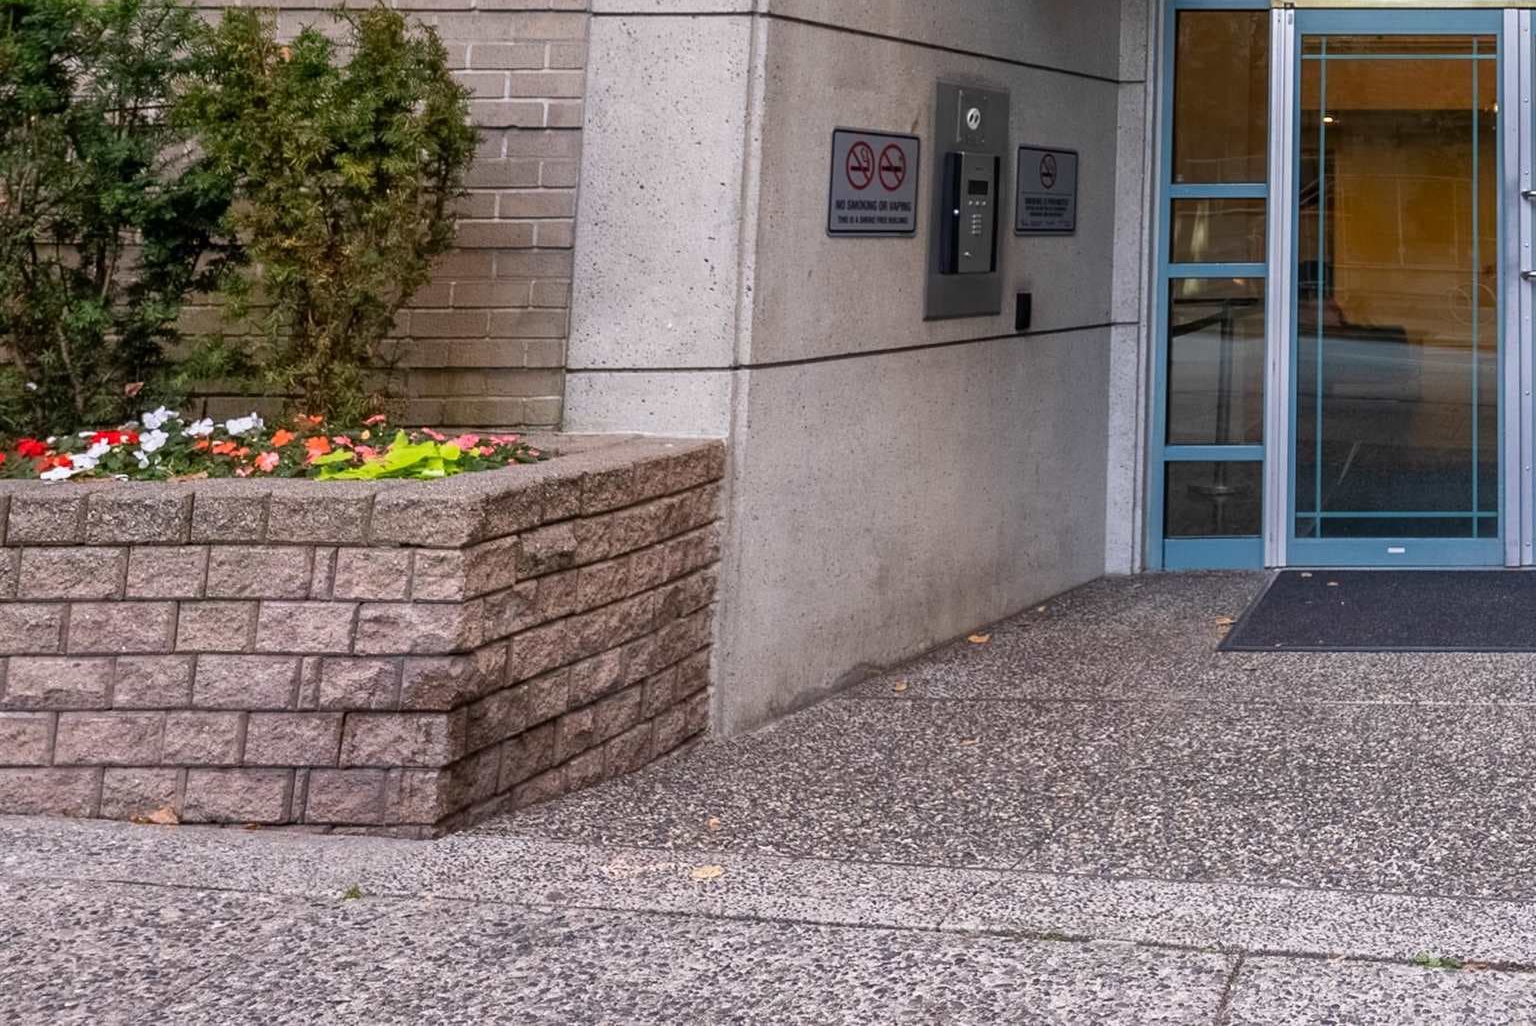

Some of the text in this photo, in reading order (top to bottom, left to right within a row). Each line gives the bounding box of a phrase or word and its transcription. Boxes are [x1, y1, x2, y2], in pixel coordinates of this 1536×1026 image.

[835, 199, 912, 212] NO SMOKING OR VAPING
